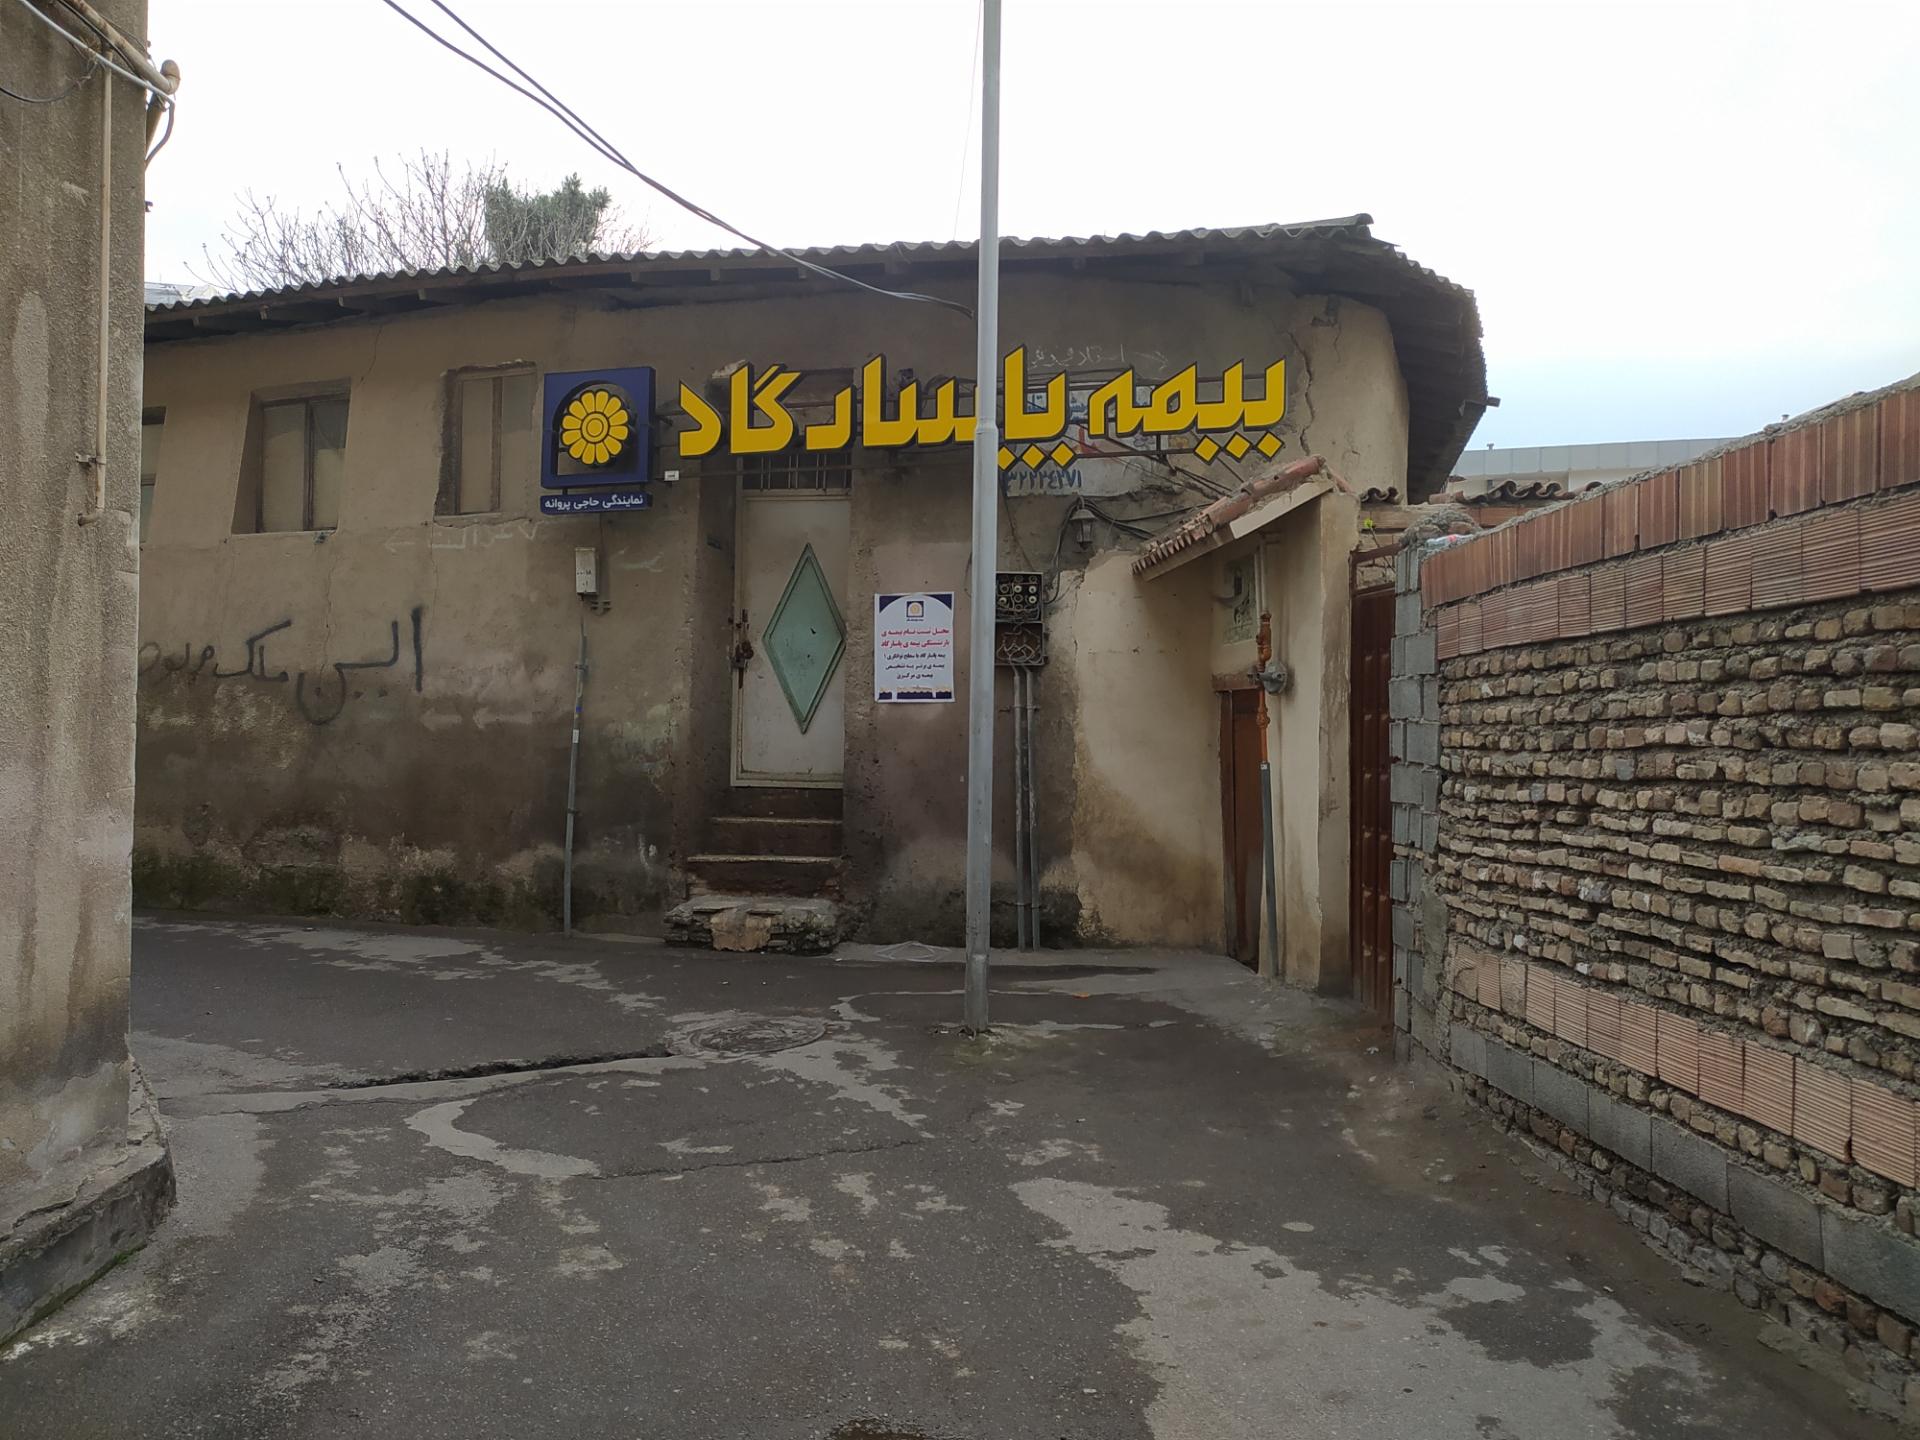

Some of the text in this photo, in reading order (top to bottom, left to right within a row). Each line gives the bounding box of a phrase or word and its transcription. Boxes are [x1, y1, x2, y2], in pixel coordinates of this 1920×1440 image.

[679, 344, 1287, 472] بیمه پاسارگاد
[544, 494, 644, 511] نمایندگی حاجی پروانه
[903, 628, 916, 636] نام
[932, 627, 949, 636] محل
